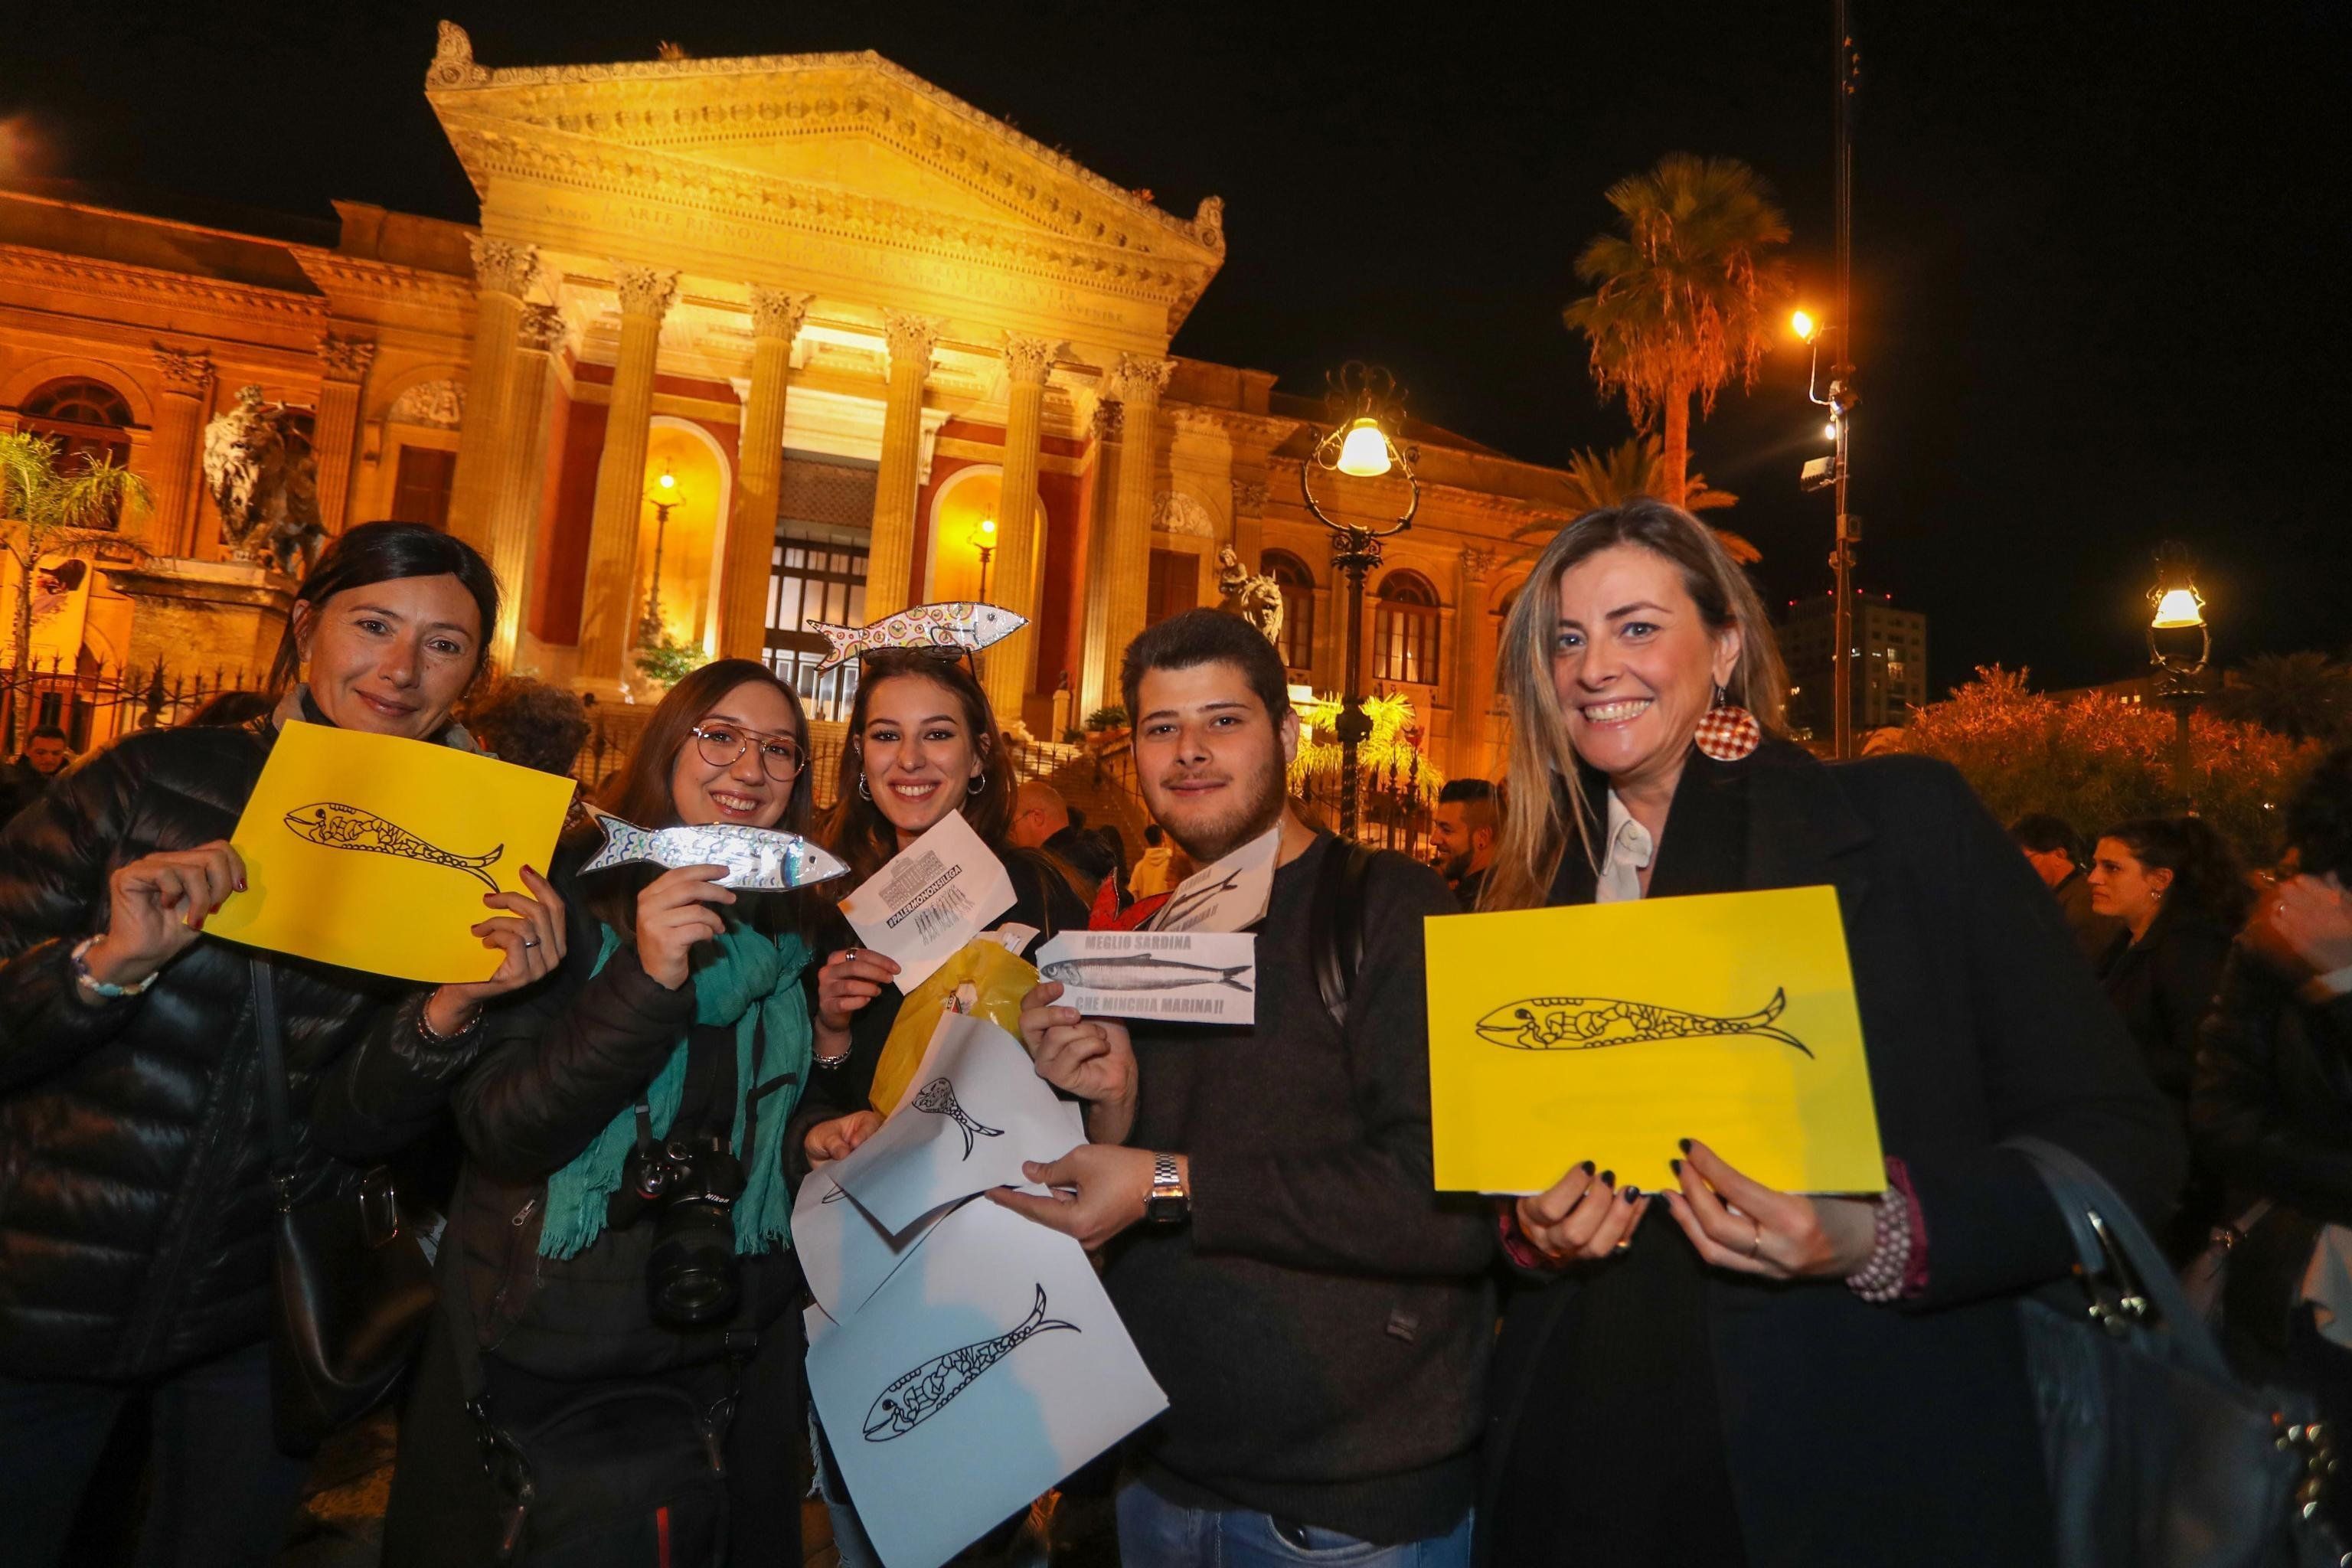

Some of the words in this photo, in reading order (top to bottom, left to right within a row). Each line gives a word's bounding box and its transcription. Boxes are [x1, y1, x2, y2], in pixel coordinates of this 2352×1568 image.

[887, 866, 961, 928] #PALERMONONSILEGA
[1085, 936, 1132, 951] MEGLIO
[1135, 936, 1191, 950] SARDINA
[1075, 997, 1100, 1012] CHE
[1102, 998, 1159, 1013] MINCHIA
[704, 1193, 730, 1204] Nikon
